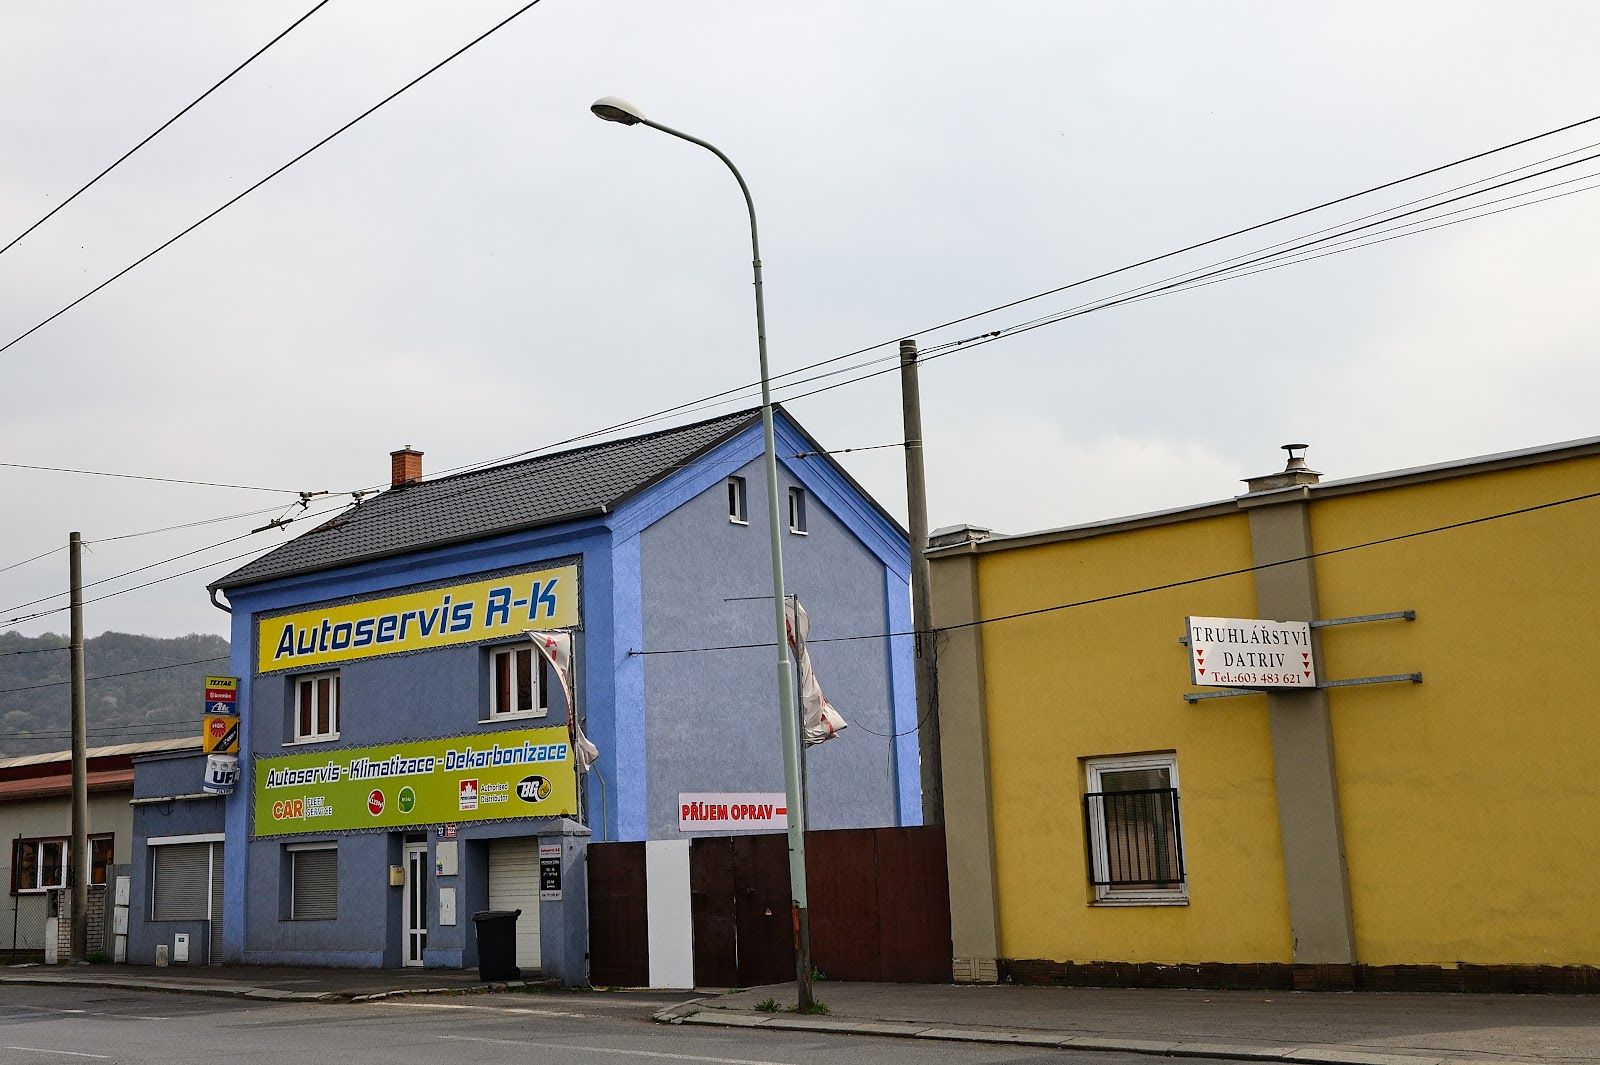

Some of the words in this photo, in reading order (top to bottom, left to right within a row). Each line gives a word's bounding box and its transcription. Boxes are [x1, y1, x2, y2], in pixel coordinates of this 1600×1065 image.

[274, 595, 475, 660] Autoservis
[484, 578, 559, 628] R-K
[1193, 625, 1309, 646] TRUHLÁŘSTVÍ
[1223, 652, 1286, 668] DATRIV
[1260, 673, 1280, 684] 483
[1283, 674, 1302, 684] 621
[266, 763, 340, 788] Autoservis
[350, 754, 435, 780] Klimatizace
[445, 742, 568, 771] Dekarbonizace
[521, 781, 540, 802] BG
[273, 799, 303, 820] CAR
[307, 797, 325, 807] FLEET
[307, 806, 332, 817] SERVICE
[682, 802, 729, 821] PŘÍJEM
[731, 804, 774, 820] OPRAV
